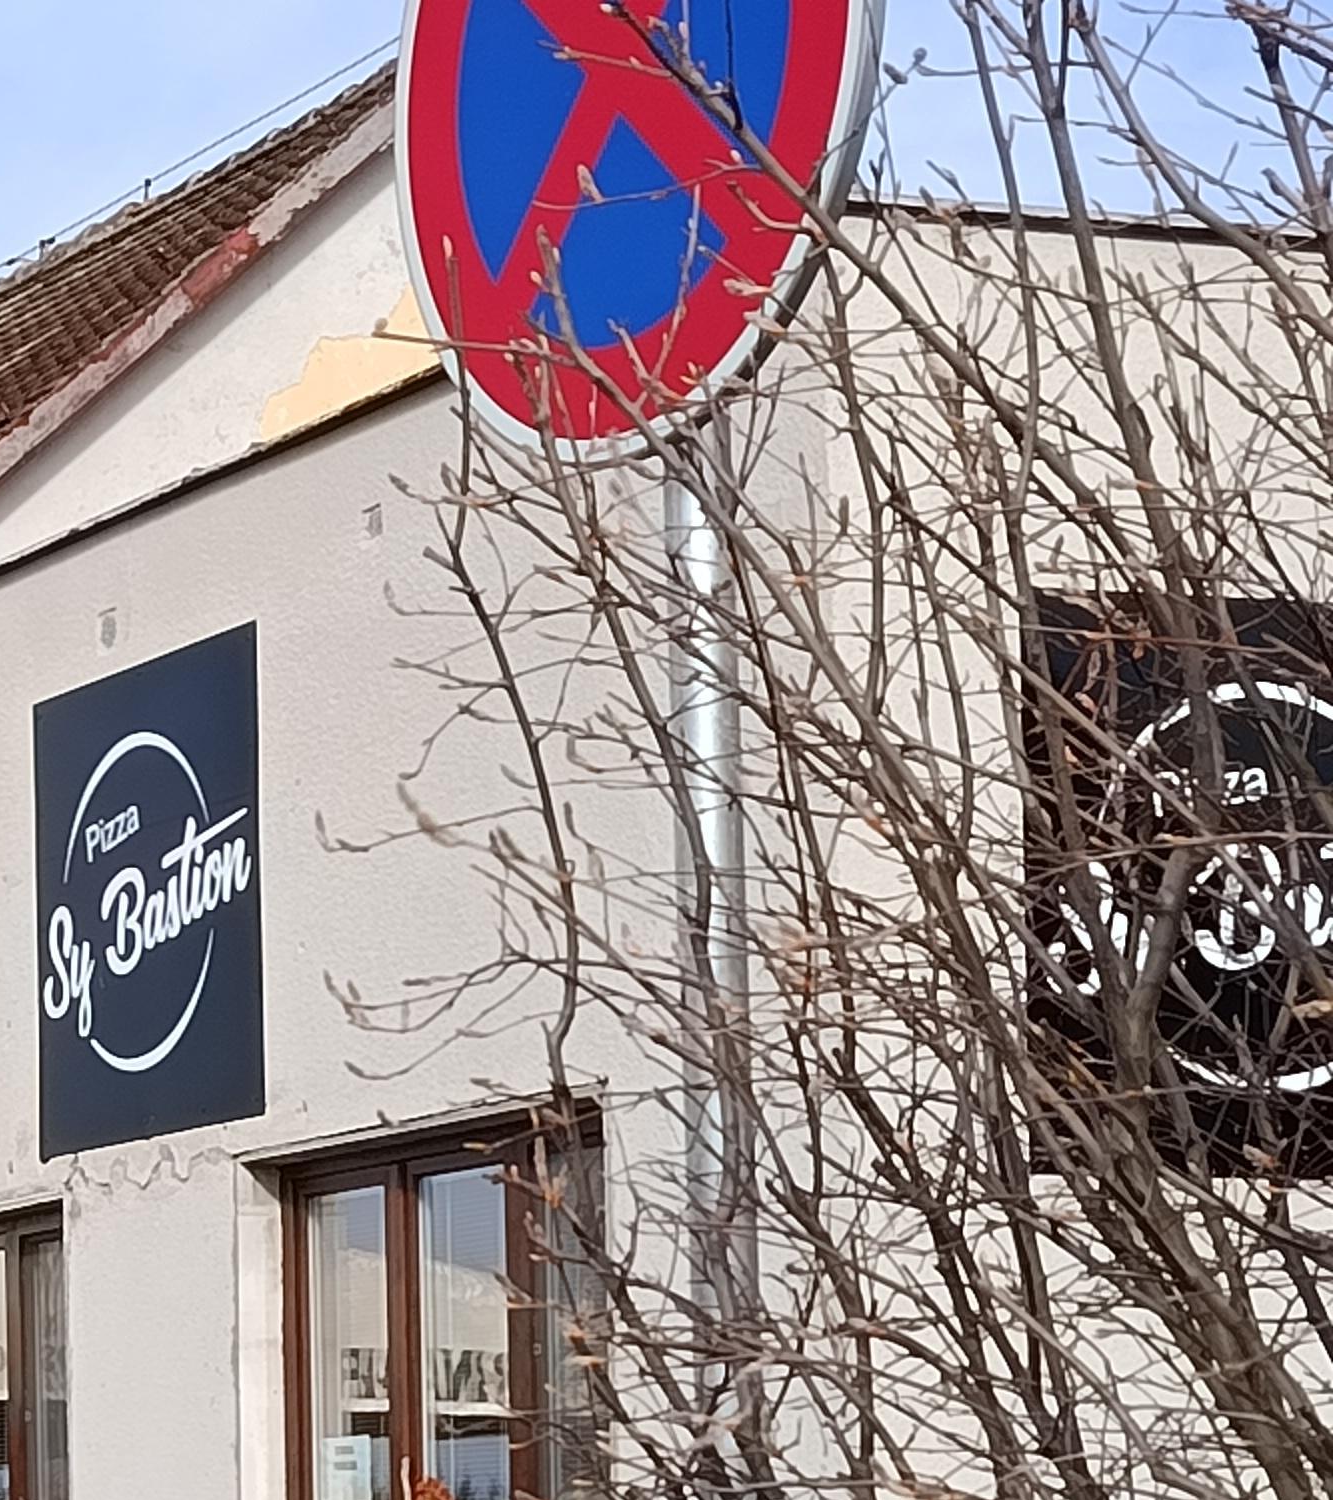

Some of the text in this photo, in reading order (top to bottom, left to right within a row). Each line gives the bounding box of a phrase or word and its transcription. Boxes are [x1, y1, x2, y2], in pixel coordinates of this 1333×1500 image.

[85, 805, 140, 863] Pizza
[44, 807, 252, 1037] Sy Bastion
